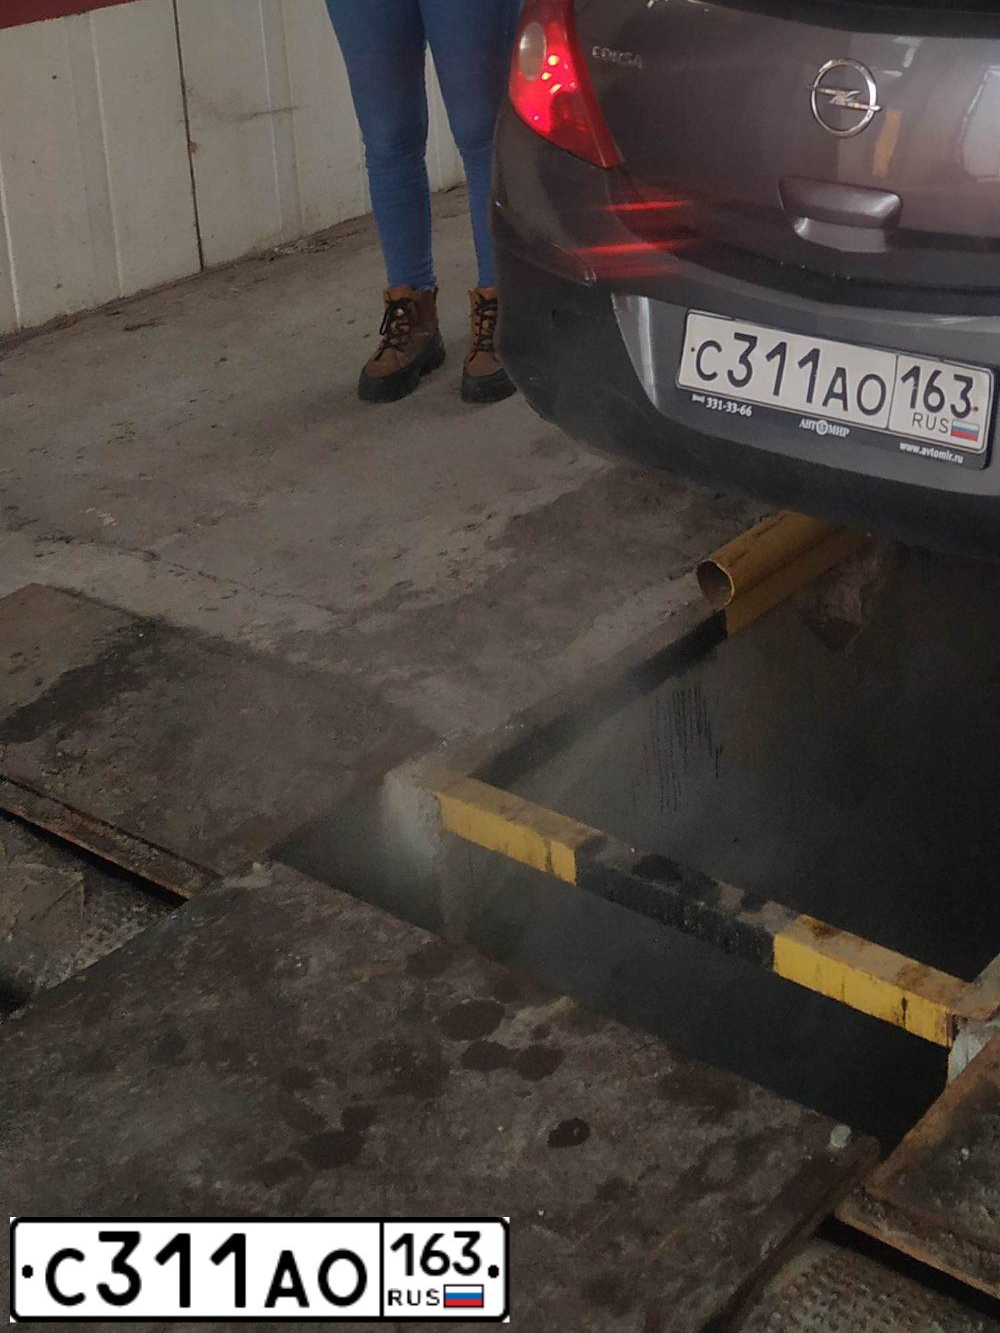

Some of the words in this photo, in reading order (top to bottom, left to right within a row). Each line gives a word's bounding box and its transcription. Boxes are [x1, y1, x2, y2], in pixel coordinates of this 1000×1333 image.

[695, 332, 887, 416] С311АО
[901, 365, 975, 418] 163
[706, 398, 752, 417] 331-33-66
[912, 412, 949, 434] RUS
[900, 442, 964, 464] www.avtomir.ru
